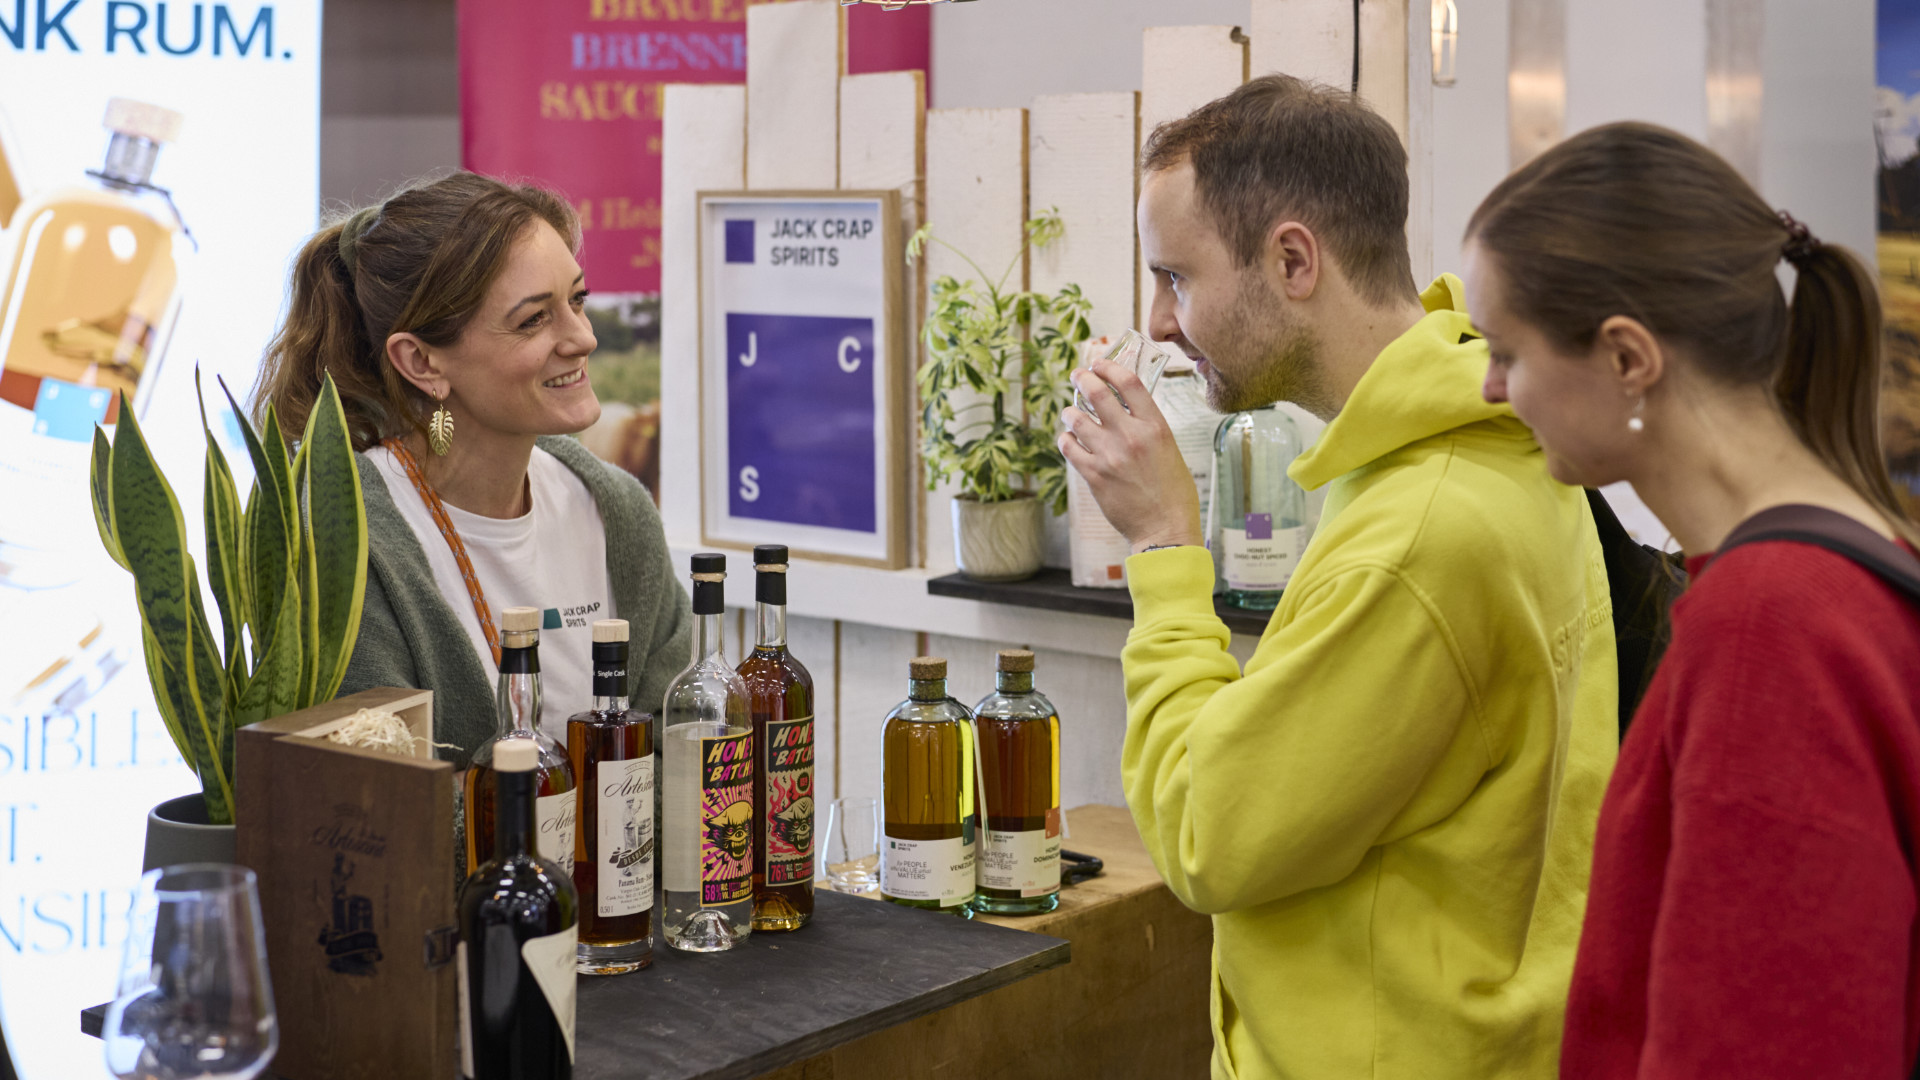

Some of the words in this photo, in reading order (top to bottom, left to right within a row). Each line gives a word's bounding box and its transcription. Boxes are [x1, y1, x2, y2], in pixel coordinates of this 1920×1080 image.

[105, 1, 293, 59] RUM.
[770, 219, 817, 239] JACK
[822, 219, 874, 240] CRAP
[770, 246, 839, 267] SPIRITS
[739, 331, 757, 367] J
[837, 335, 861, 373] C
[739, 465, 760, 502] S
[576, 602, 601, 616] CRAP
[597, 670, 613, 679] Single
[614, 669, 625, 677] Cask
[773, 722, 814, 748] HONE
[771, 863, 787, 882] 76%
[898, 872, 926, 880] MATTERS
[985, 862, 1012, 871] MATTERS
[705, 881, 721, 902] 58%
